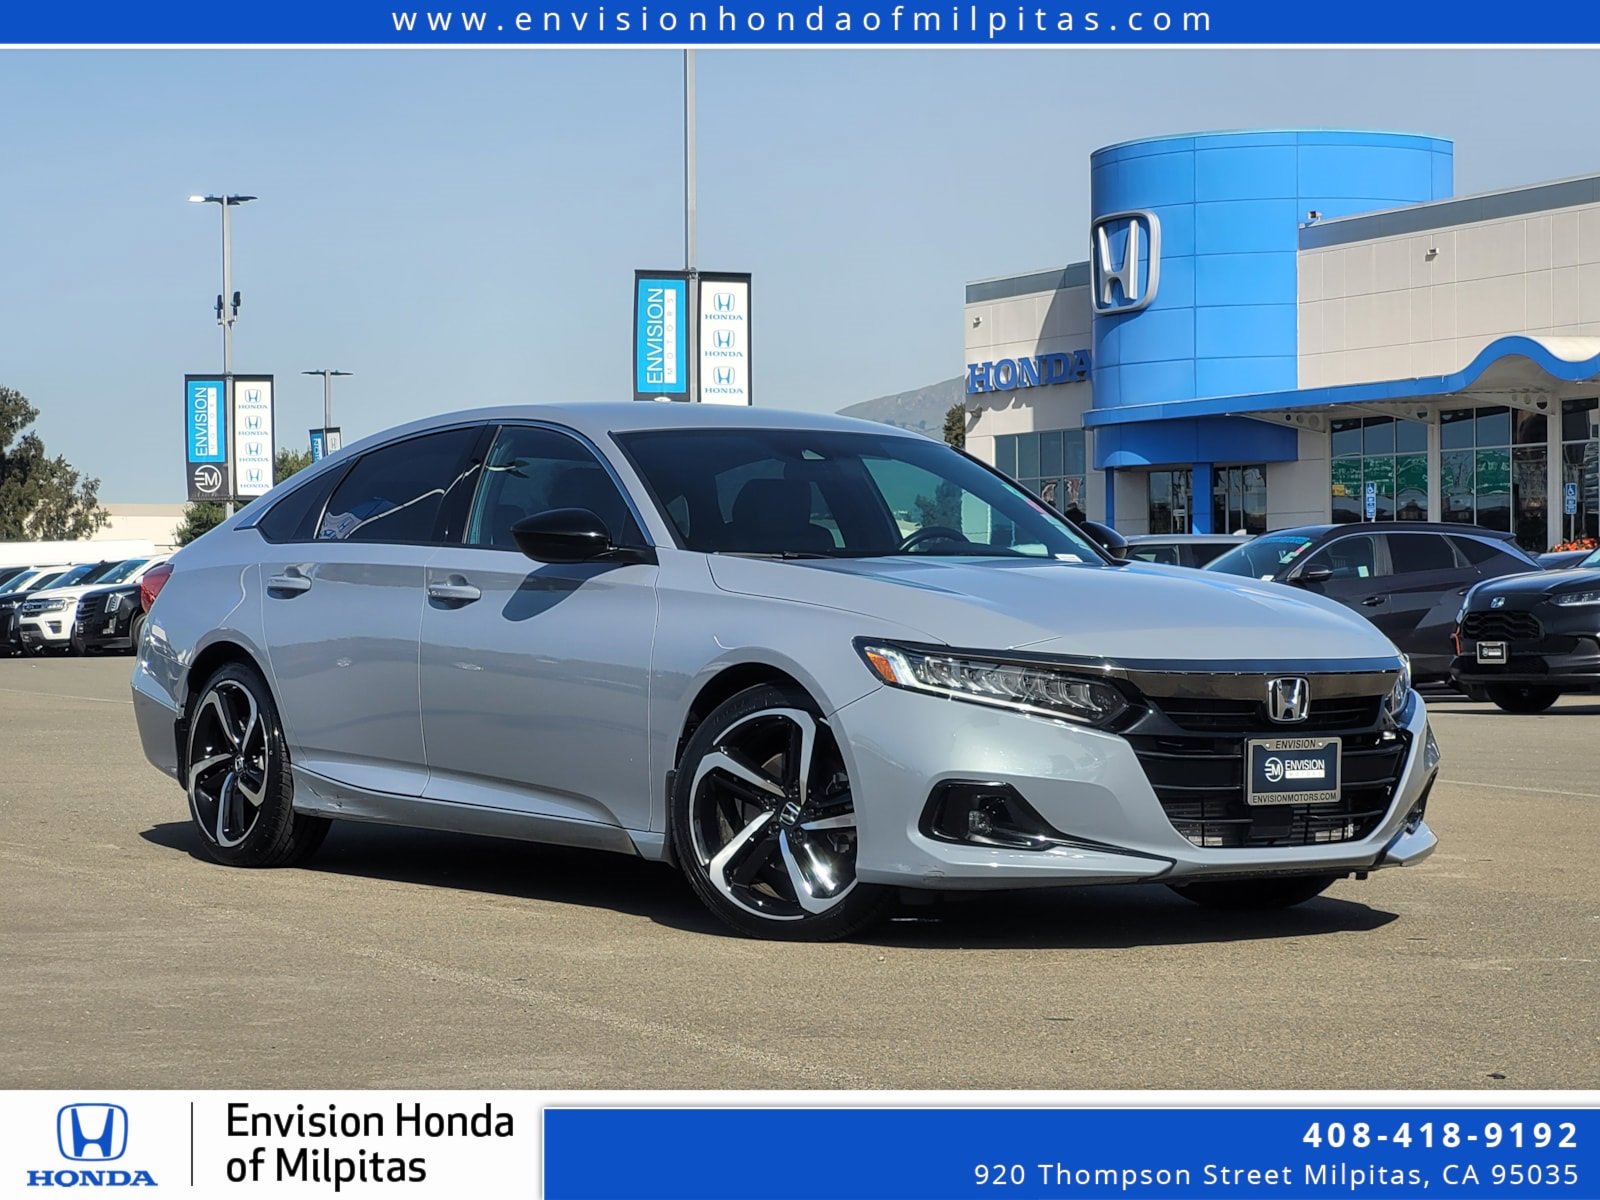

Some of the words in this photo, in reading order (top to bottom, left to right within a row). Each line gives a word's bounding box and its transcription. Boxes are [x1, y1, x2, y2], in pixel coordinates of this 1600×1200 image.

[647, 288, 663, 384] ENVISION
[967, 349, 1092, 393] HONDA
[195, 387, 208, 456] ENVISION
[1275, 739, 1316, 749] ENVISION
[1285, 759, 1325, 771] ENVISION
[1252, 792, 1337, 804] ENVISIONMOTORS.COM
